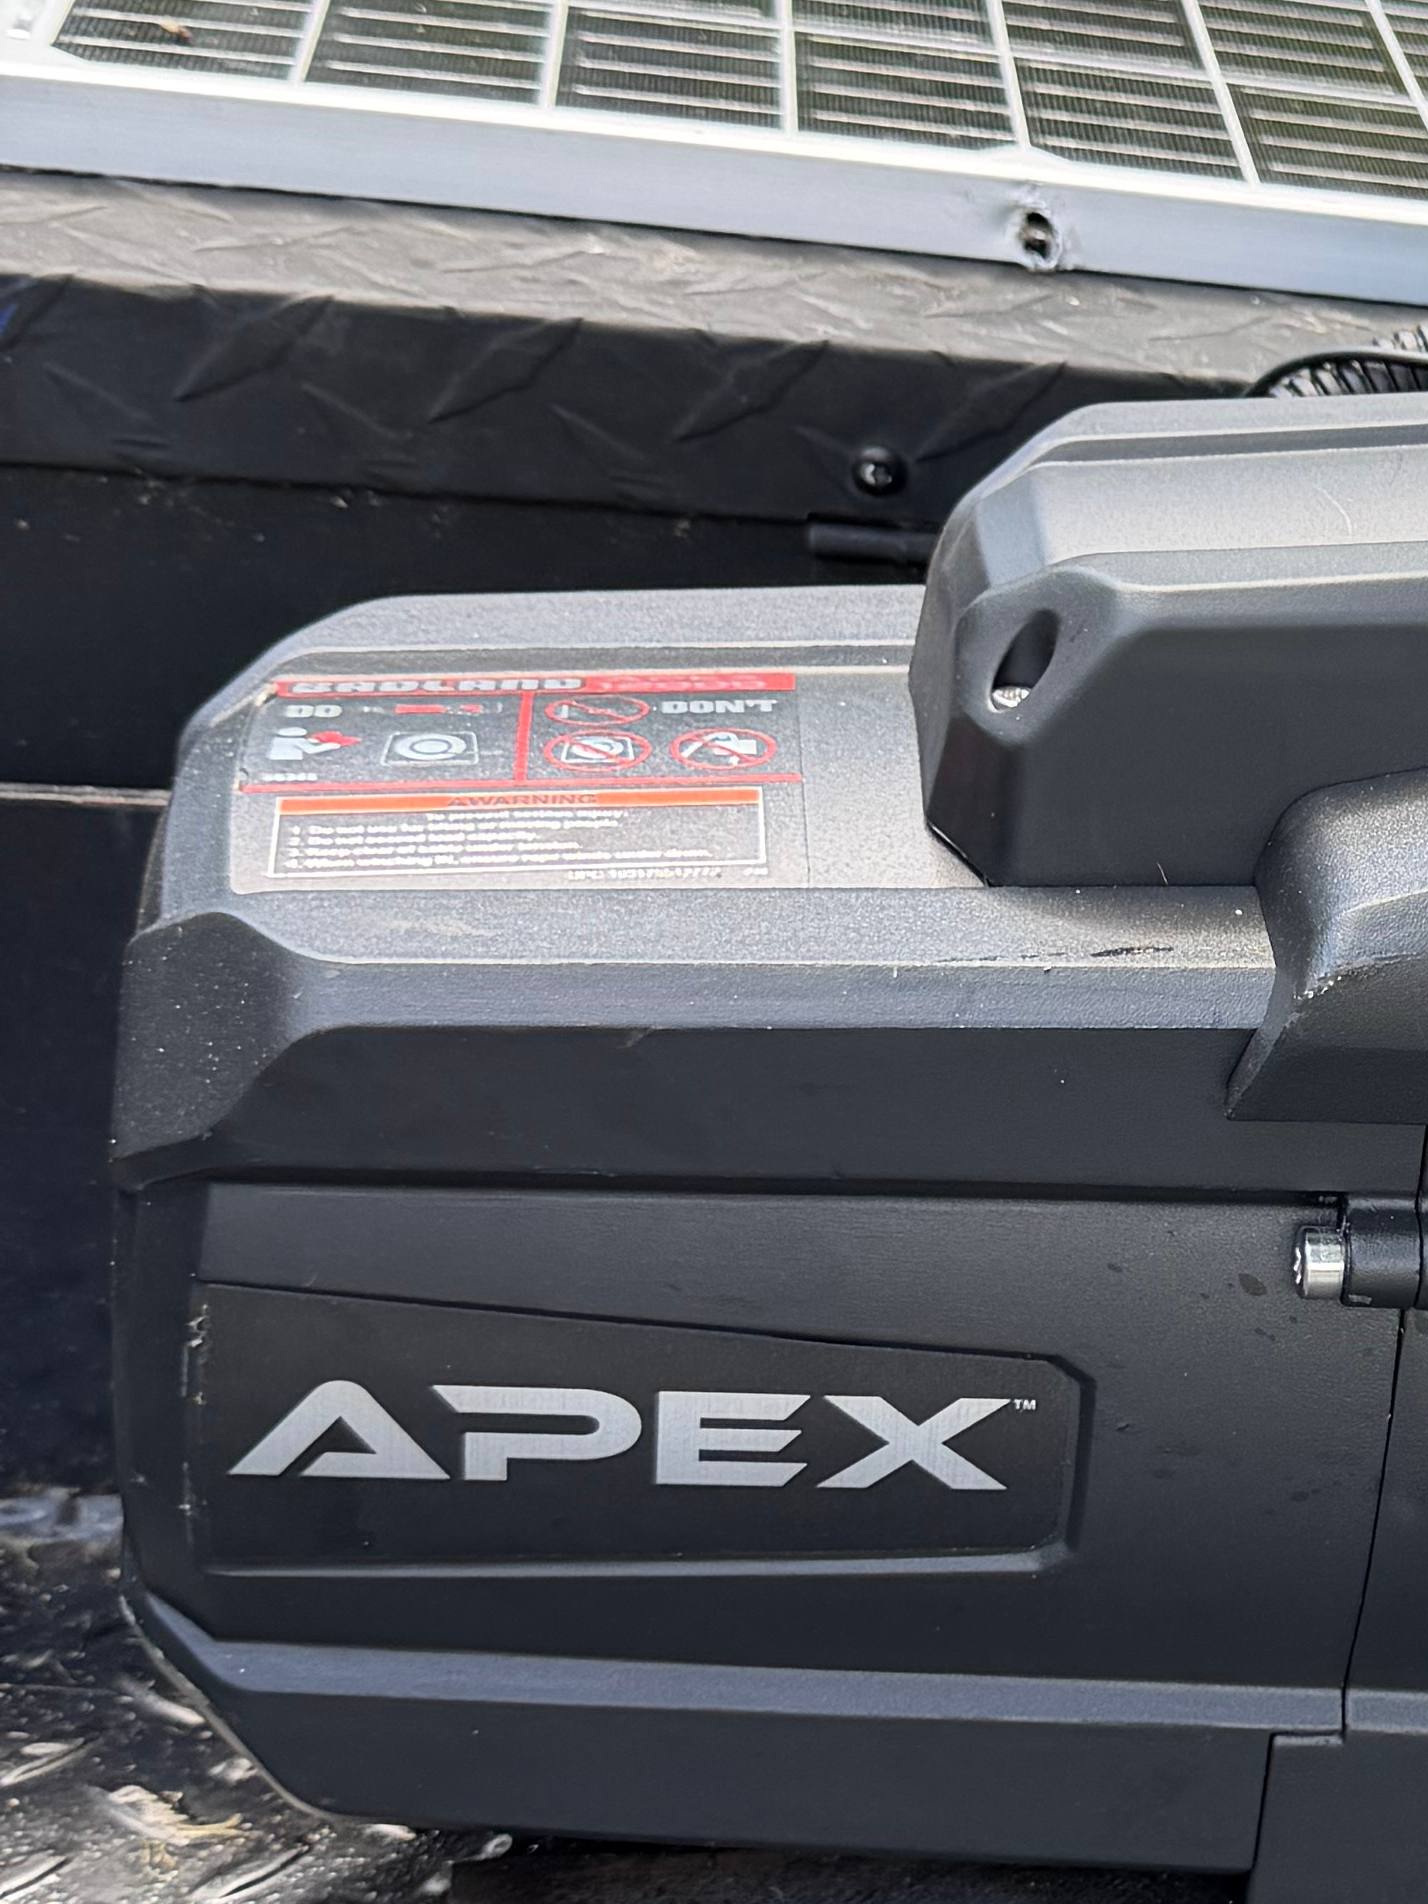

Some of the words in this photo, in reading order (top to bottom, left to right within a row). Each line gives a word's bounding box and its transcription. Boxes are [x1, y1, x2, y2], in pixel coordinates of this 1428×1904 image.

[285, 704, 343, 718] DO
[660, 700, 778, 714] DON'T
[467, 794, 597, 806] WARNING
[227, 1379, 1011, 1492] APEX
